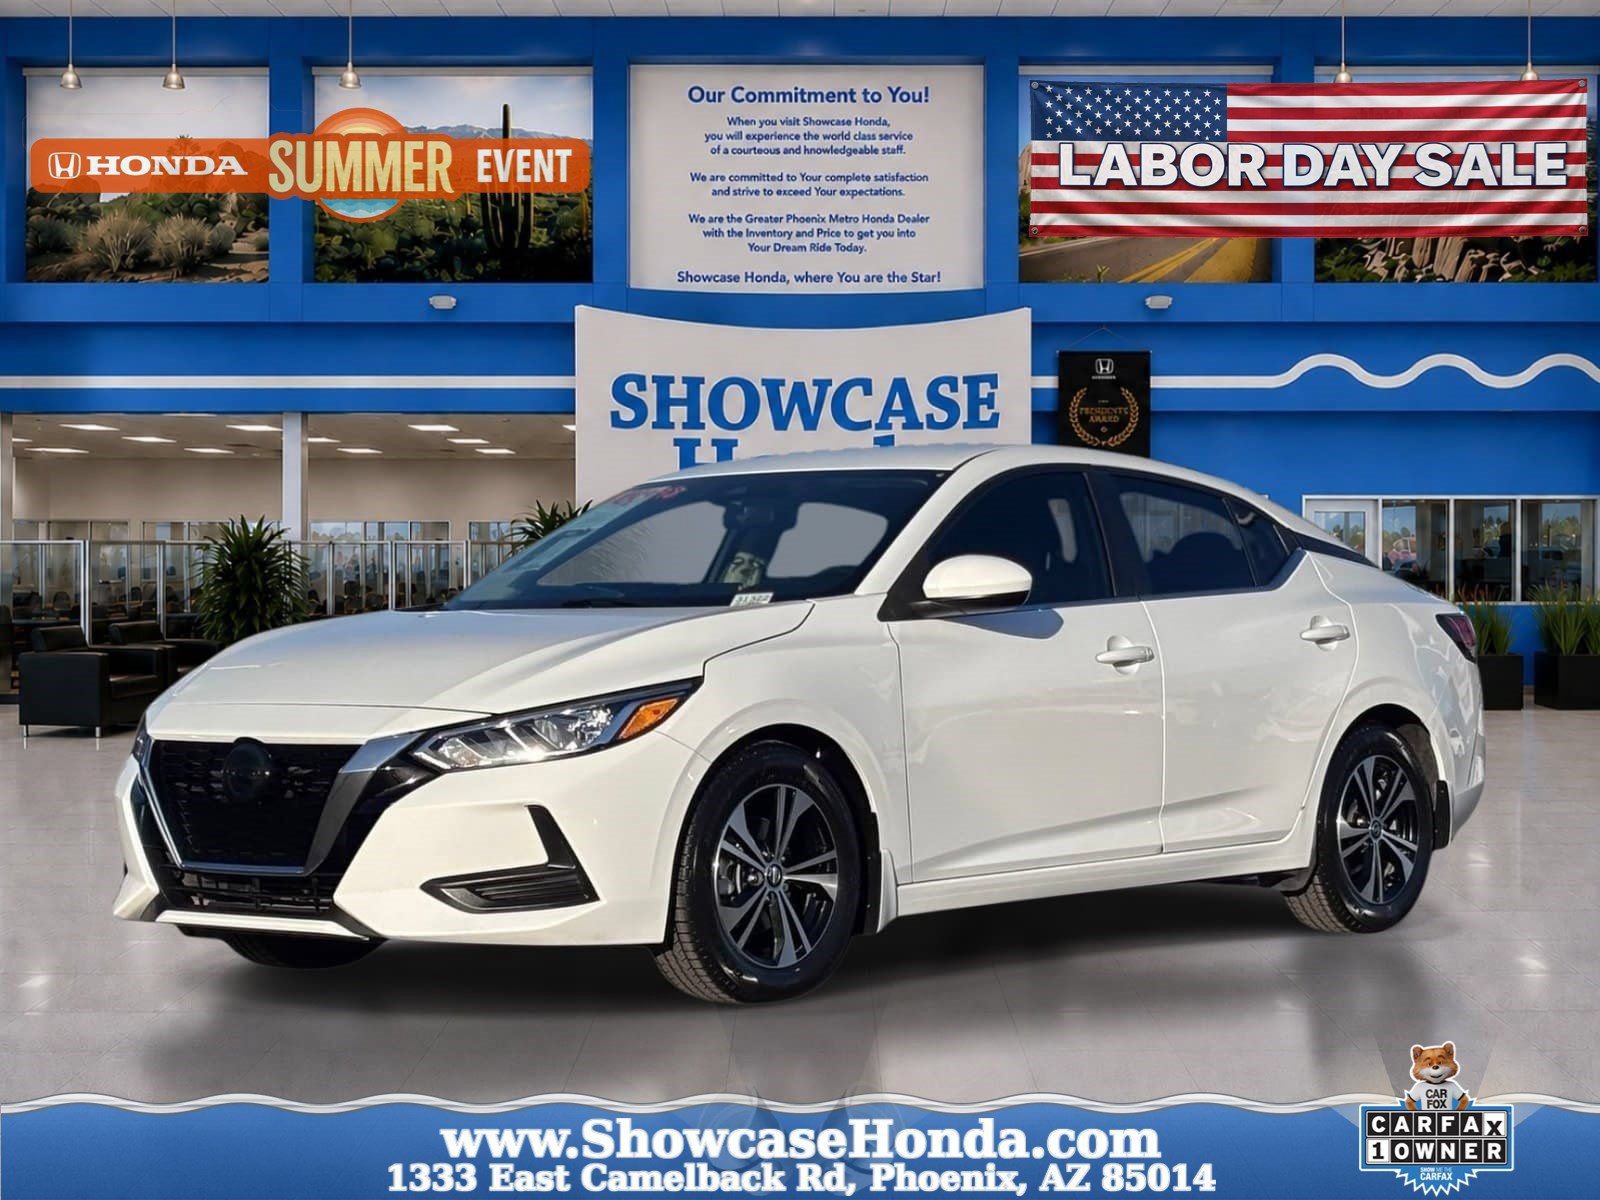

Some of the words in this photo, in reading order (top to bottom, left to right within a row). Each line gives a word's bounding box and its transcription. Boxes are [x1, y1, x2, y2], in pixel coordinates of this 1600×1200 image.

[687, 85, 727, 104] Our
[730, 85, 858, 104] Commitment
[860, 87, 883, 104] to
[886, 85, 930, 104] You!
[726, 115, 757, 127] When
[758, 118, 778, 129] you
[779, 116, 801, 127] visit
[802, 116, 853, 127] Showcase
[854, 116, 891, 128] Honda,
[704, 133, 724, 144] you
[724, 130, 744, 141] will
[744, 130, 801, 144] experience
[802, 130, 820, 141] the
[821, 130, 852, 142] world
[852, 130, 877, 141] class
[878, 130, 914, 141] service
[709, 144, 721, 155] of
[722, 147, 730, 155] a
[730, 146, 782, 156] courteous
[782, 144, 802, 155] and
[881, 144, 906, 156] staff.
[86, 155, 248, 176] HONDA
[268, 139, 456, 194] SUMMER
[477, 148, 572, 183] EVENT
[1058, 142, 1268, 188] LABOR
[1282, 142, 1405, 188] DAY
[1414, 142, 1568, 188] SALE
[689, 171, 708, 183] We
[708, 174, 727, 182] are
[728, 171, 784, 183] committed
[785, 173, 798, 183] to
[799, 171, 823, 183] Your
[824, 172, 872, 185] complete
[873, 171, 929, 183] satisfaction
[711, 185, 731, 197] and
[731, 186, 761, 197] strive
[762, 187, 774, 197] to
[775, 186, 812, 197] exceed
[813, 186, 838, 197] Your
[838, 186, 905, 200] expectations.
[687, 213, 706, 224] We
[707, 215, 725, 225] are
[725, 213, 743, 224] the
[744, 213, 785, 224] Greater
[785, 213, 827, 224] Phoenix
[828, 213, 860, 224] Metro
[861, 213, 895, 224] Honda
[897, 213, 931, 224] Dealer
[702, 227, 725, 238] with
[726, 227, 744, 239] the
[745, 227, 794, 241] Inventory
[794, 227, 815, 239] and
[816, 227, 842, 239] Price
[843, 229, 855, 238] to
[856, 229, 875, 241] get
[875, 230, 895, 241] you
[896, 227, 917, 239] into
[747, 242, 772, 253] Your
[772, 242, 808, 253] Dream
[809, 242, 833, 253] Ride
[833, 242, 867, 255] Today.
[676, 270, 741, 284] Showcase
[744, 270, 790, 286] Honda,
[793, 270, 834, 284] where
[836, 271, 861, 284] You
[863, 274, 884, 284] are
[886, 270, 908, 284] the
[910, 271, 941, 284] Star!
[610, 373, 1000, 432] SHOWCASE
